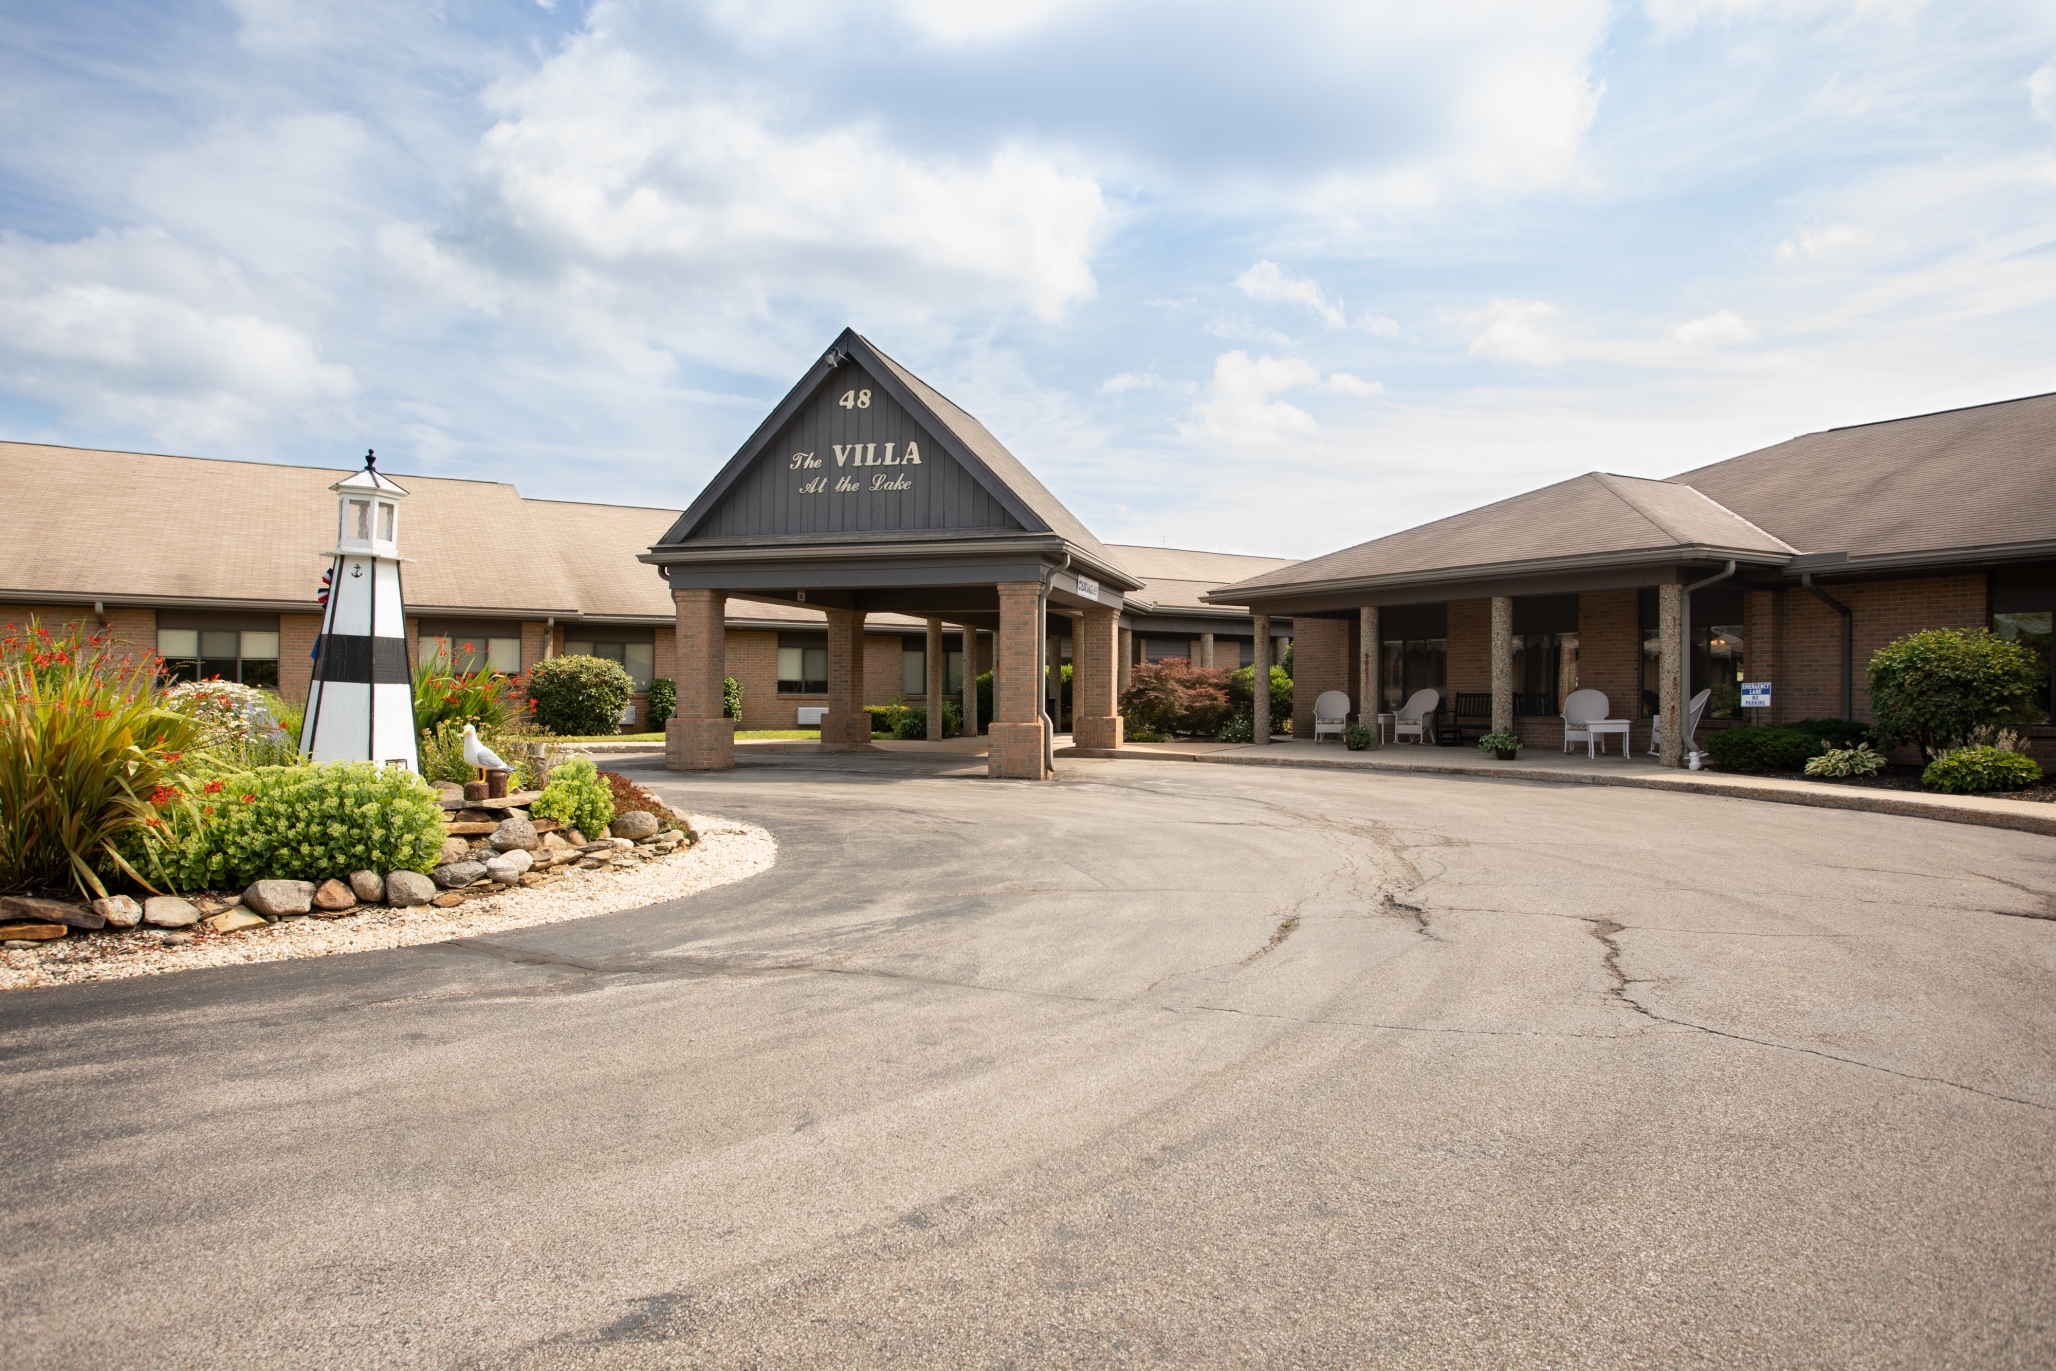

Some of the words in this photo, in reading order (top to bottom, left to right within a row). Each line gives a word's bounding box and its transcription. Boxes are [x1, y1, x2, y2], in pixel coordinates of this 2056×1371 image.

[839, 389, 872, 409] 48
[789, 452, 822, 469] The
[832, 441, 922, 467] VILLA
[799, 476, 828, 494] At
[834, 475, 860, 492] the
[869, 473, 912, 491] Lake
